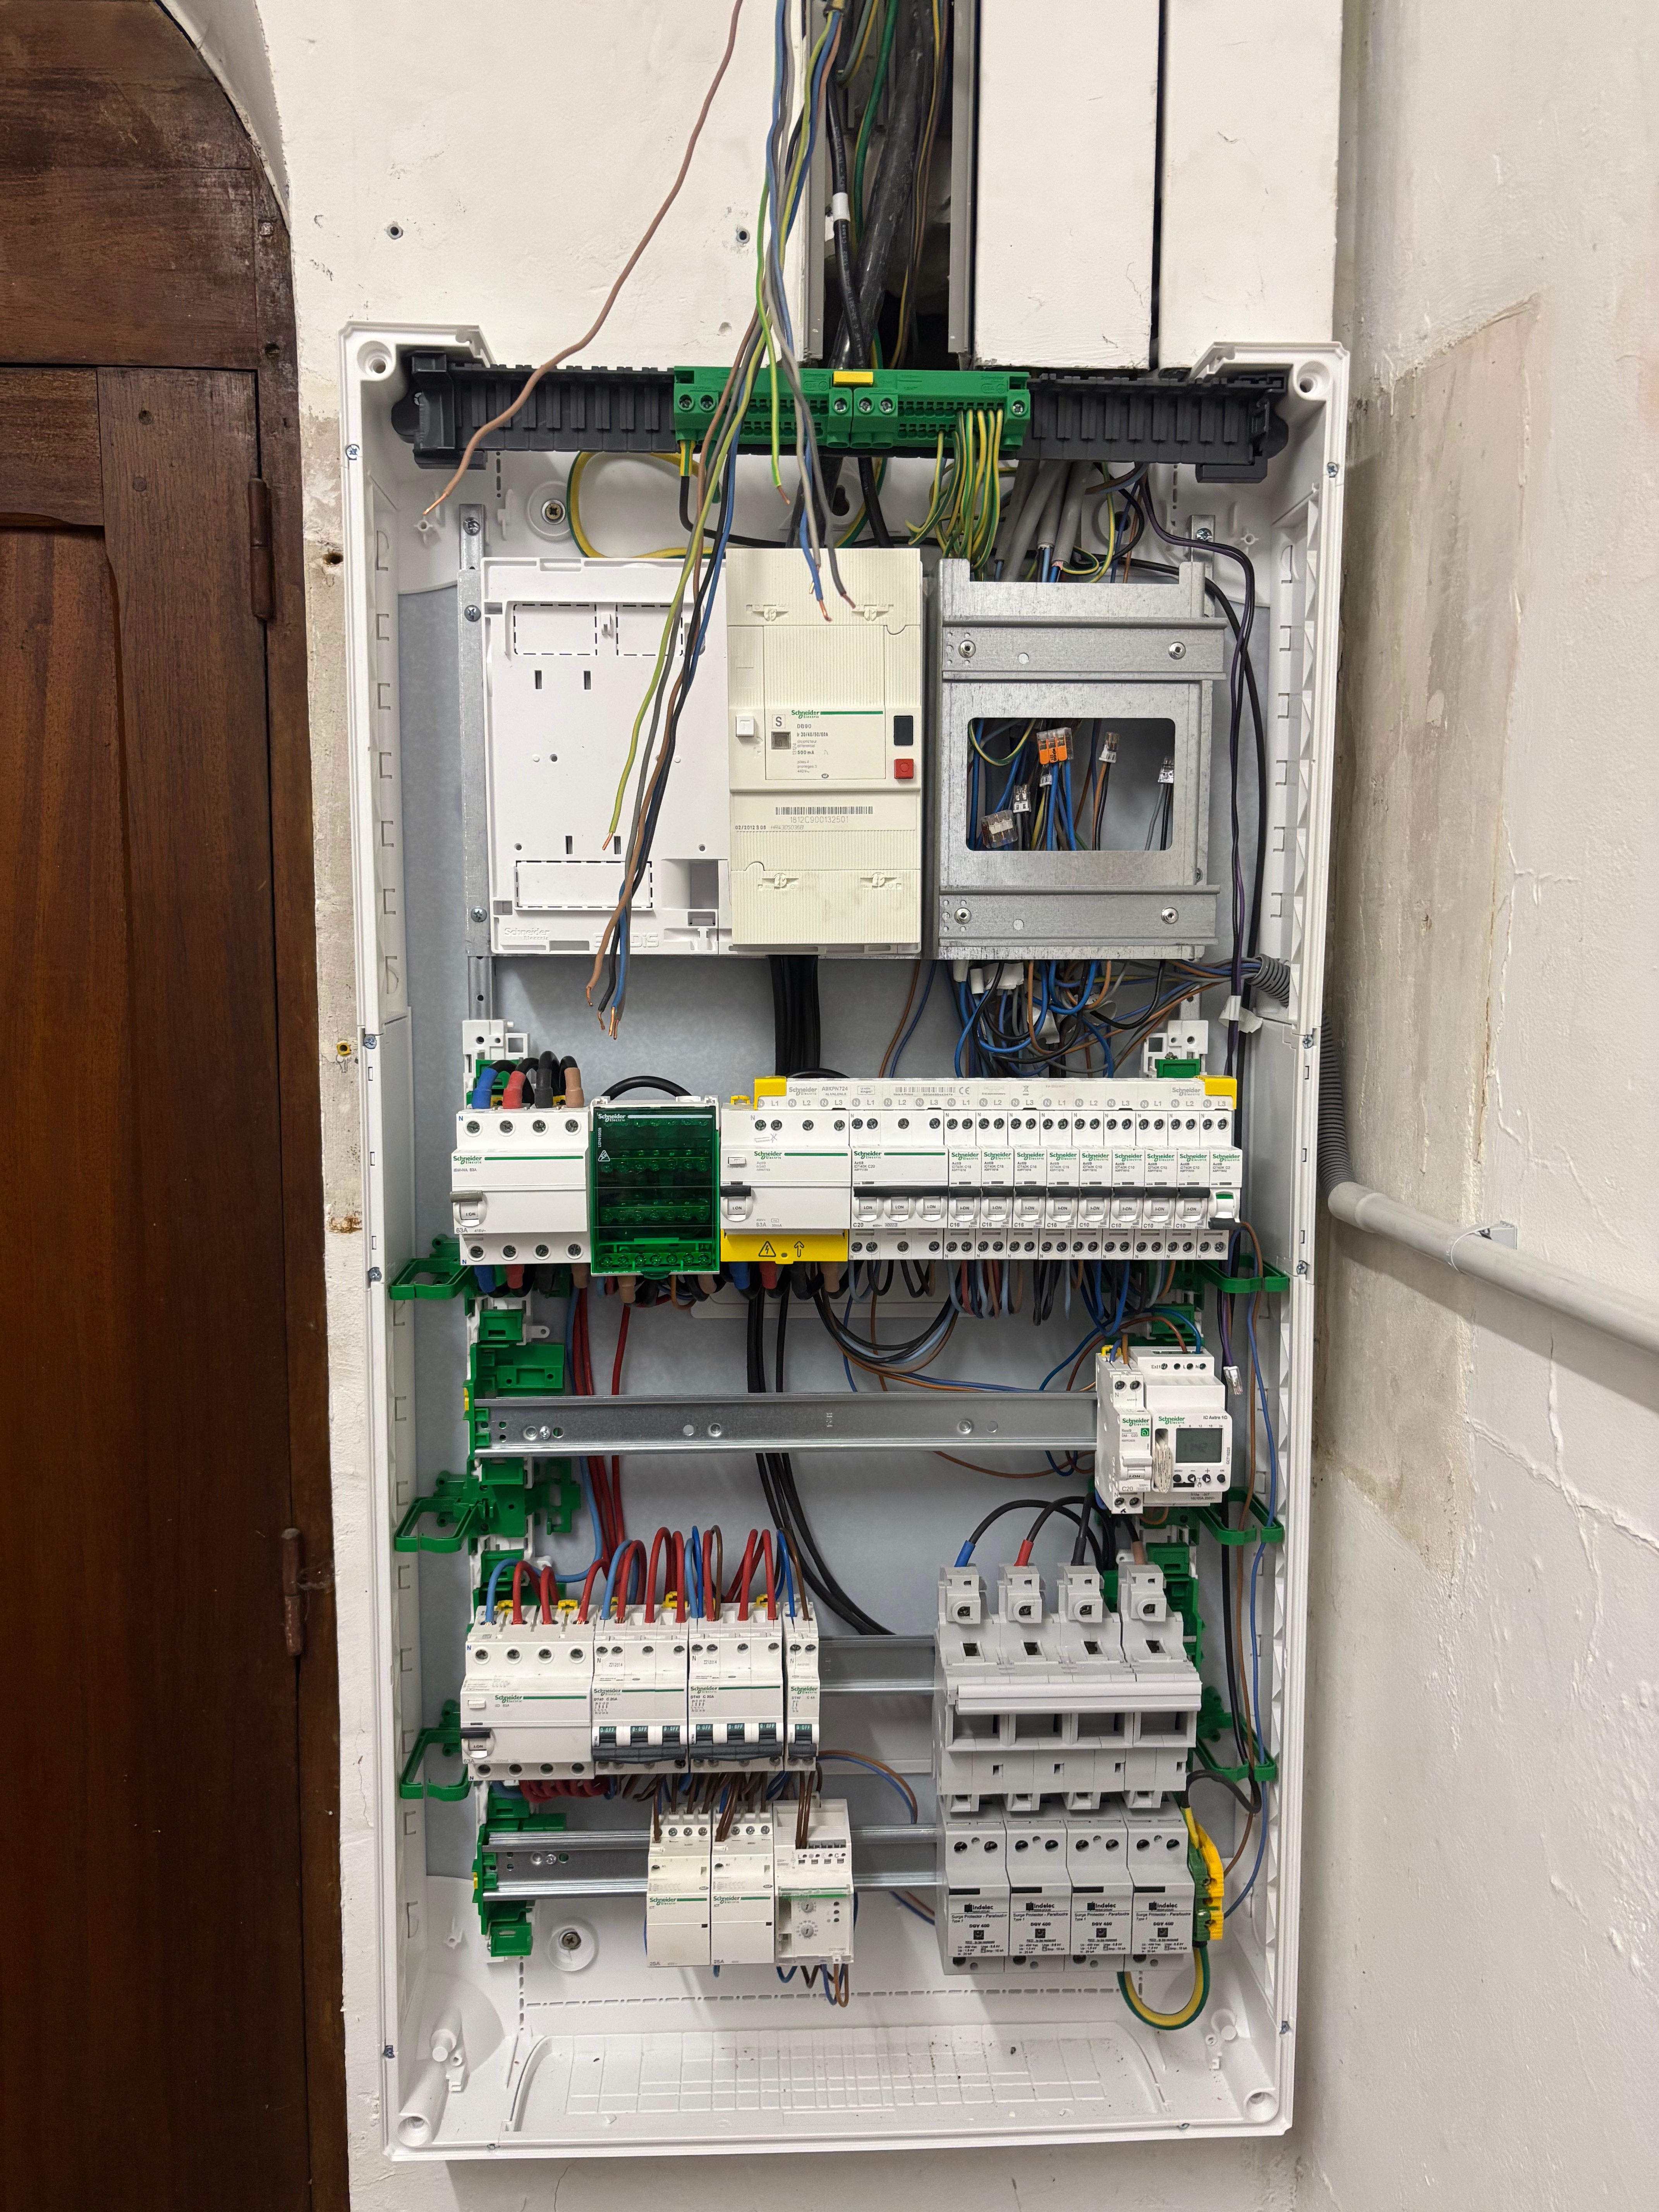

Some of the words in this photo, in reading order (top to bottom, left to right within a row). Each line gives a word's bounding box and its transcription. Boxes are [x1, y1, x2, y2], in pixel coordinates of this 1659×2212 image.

[792, 710, 820, 719] Schneider
[776, 716, 782, 726] S
[505, 928, 550, 937] Schneider
[594, 933, 659, 948] EDiS
[789, 1087, 817, 1096] Schneider
[1172, 1087, 1200, 1096] Schneider
[598, 1114, 626, 1122] Schneider
[754, 1151, 782, 1159] Schneider
[854, 1151, 881, 1159] Schneider
[984, 1152, 1012, 1160] Schneider
[1017, 1152, 1044, 1160] Schneider
[1049, 1152, 1077, 1161] Schneider
[453, 1156, 482, 1164] Schneider
[1159, 1416, 1185, 1424] Schneider
[495, 1695, 522, 1703] Schneider
